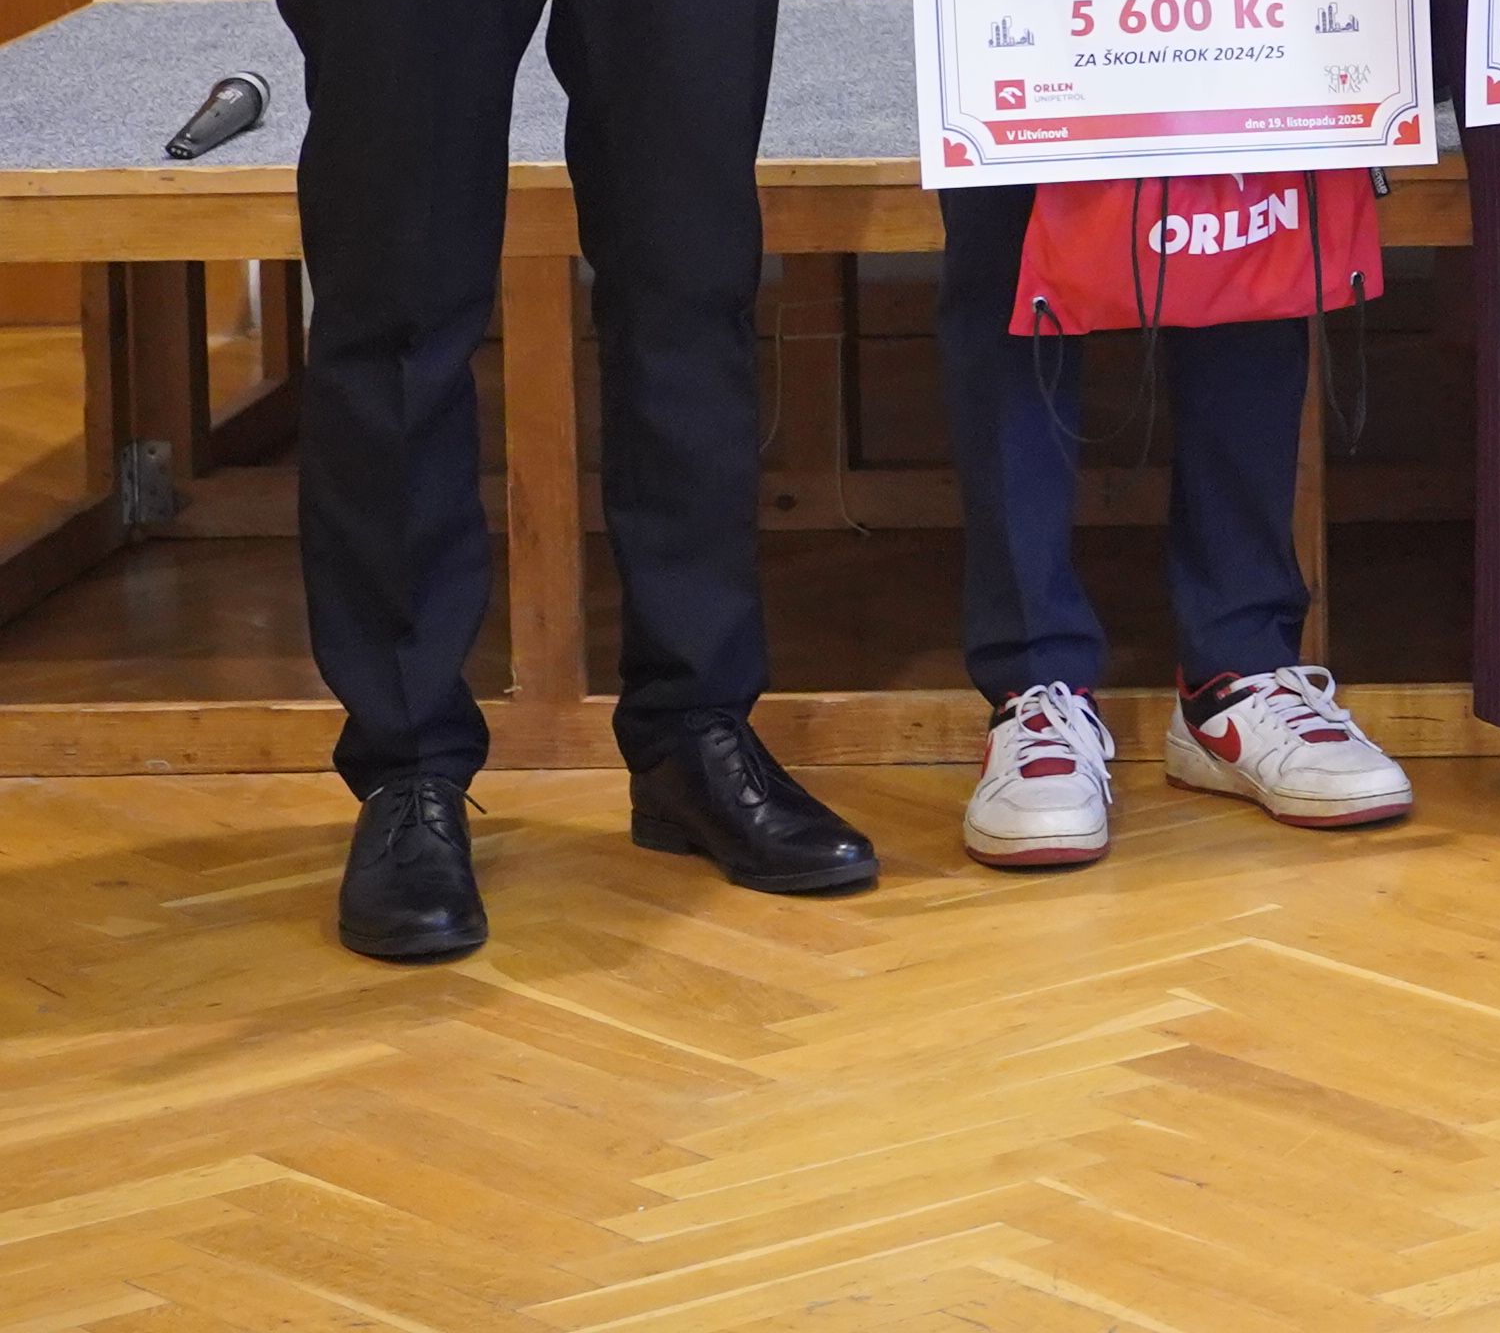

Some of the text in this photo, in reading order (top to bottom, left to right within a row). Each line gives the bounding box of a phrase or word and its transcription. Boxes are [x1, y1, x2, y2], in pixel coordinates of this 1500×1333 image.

[1071, 0, 1095, 37] 5
[1074, 44, 1285, 67] ZA ŠKOLNÍ ROK 2024/25
[1149, 189, 1298, 255] ORLEN
